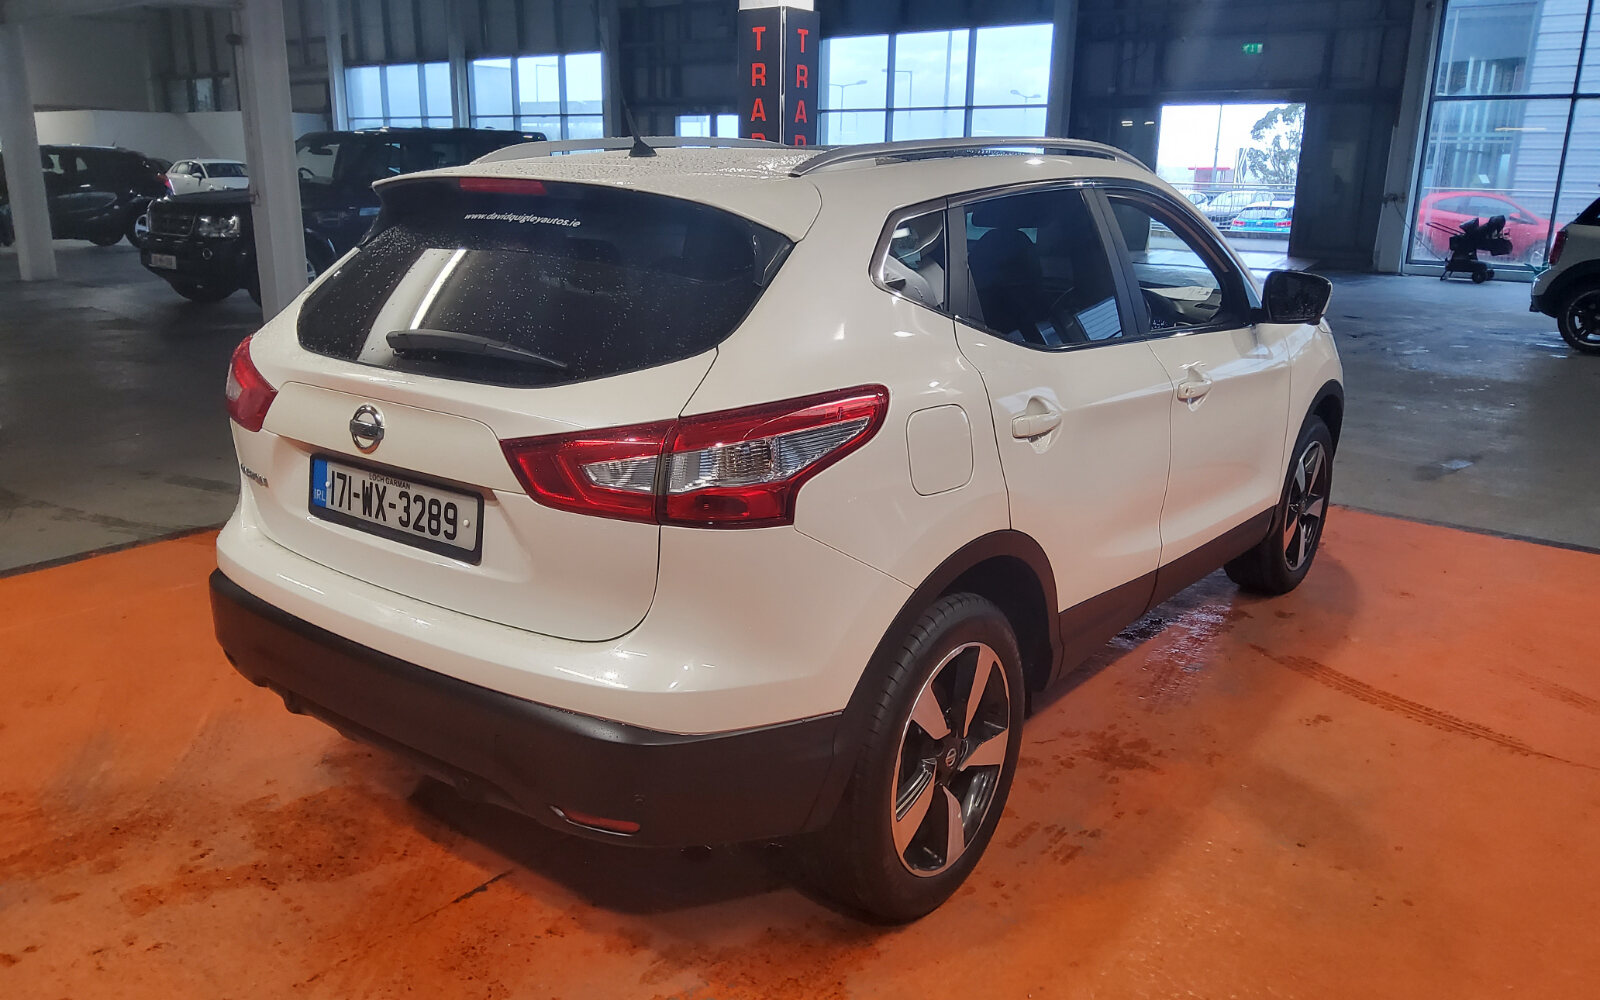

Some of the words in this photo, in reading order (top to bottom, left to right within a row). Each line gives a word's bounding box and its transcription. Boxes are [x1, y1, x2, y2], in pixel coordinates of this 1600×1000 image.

[751, 26, 767, 140] TRA
[464, 212, 581, 228] www.davidquigleyautos.ie
[368, 472, 385, 484] LOCH
[385, 476, 411, 490] GARMAN
[313, 488, 326, 502] IRL
[330, 470, 458, 541] 171-WX-3289
